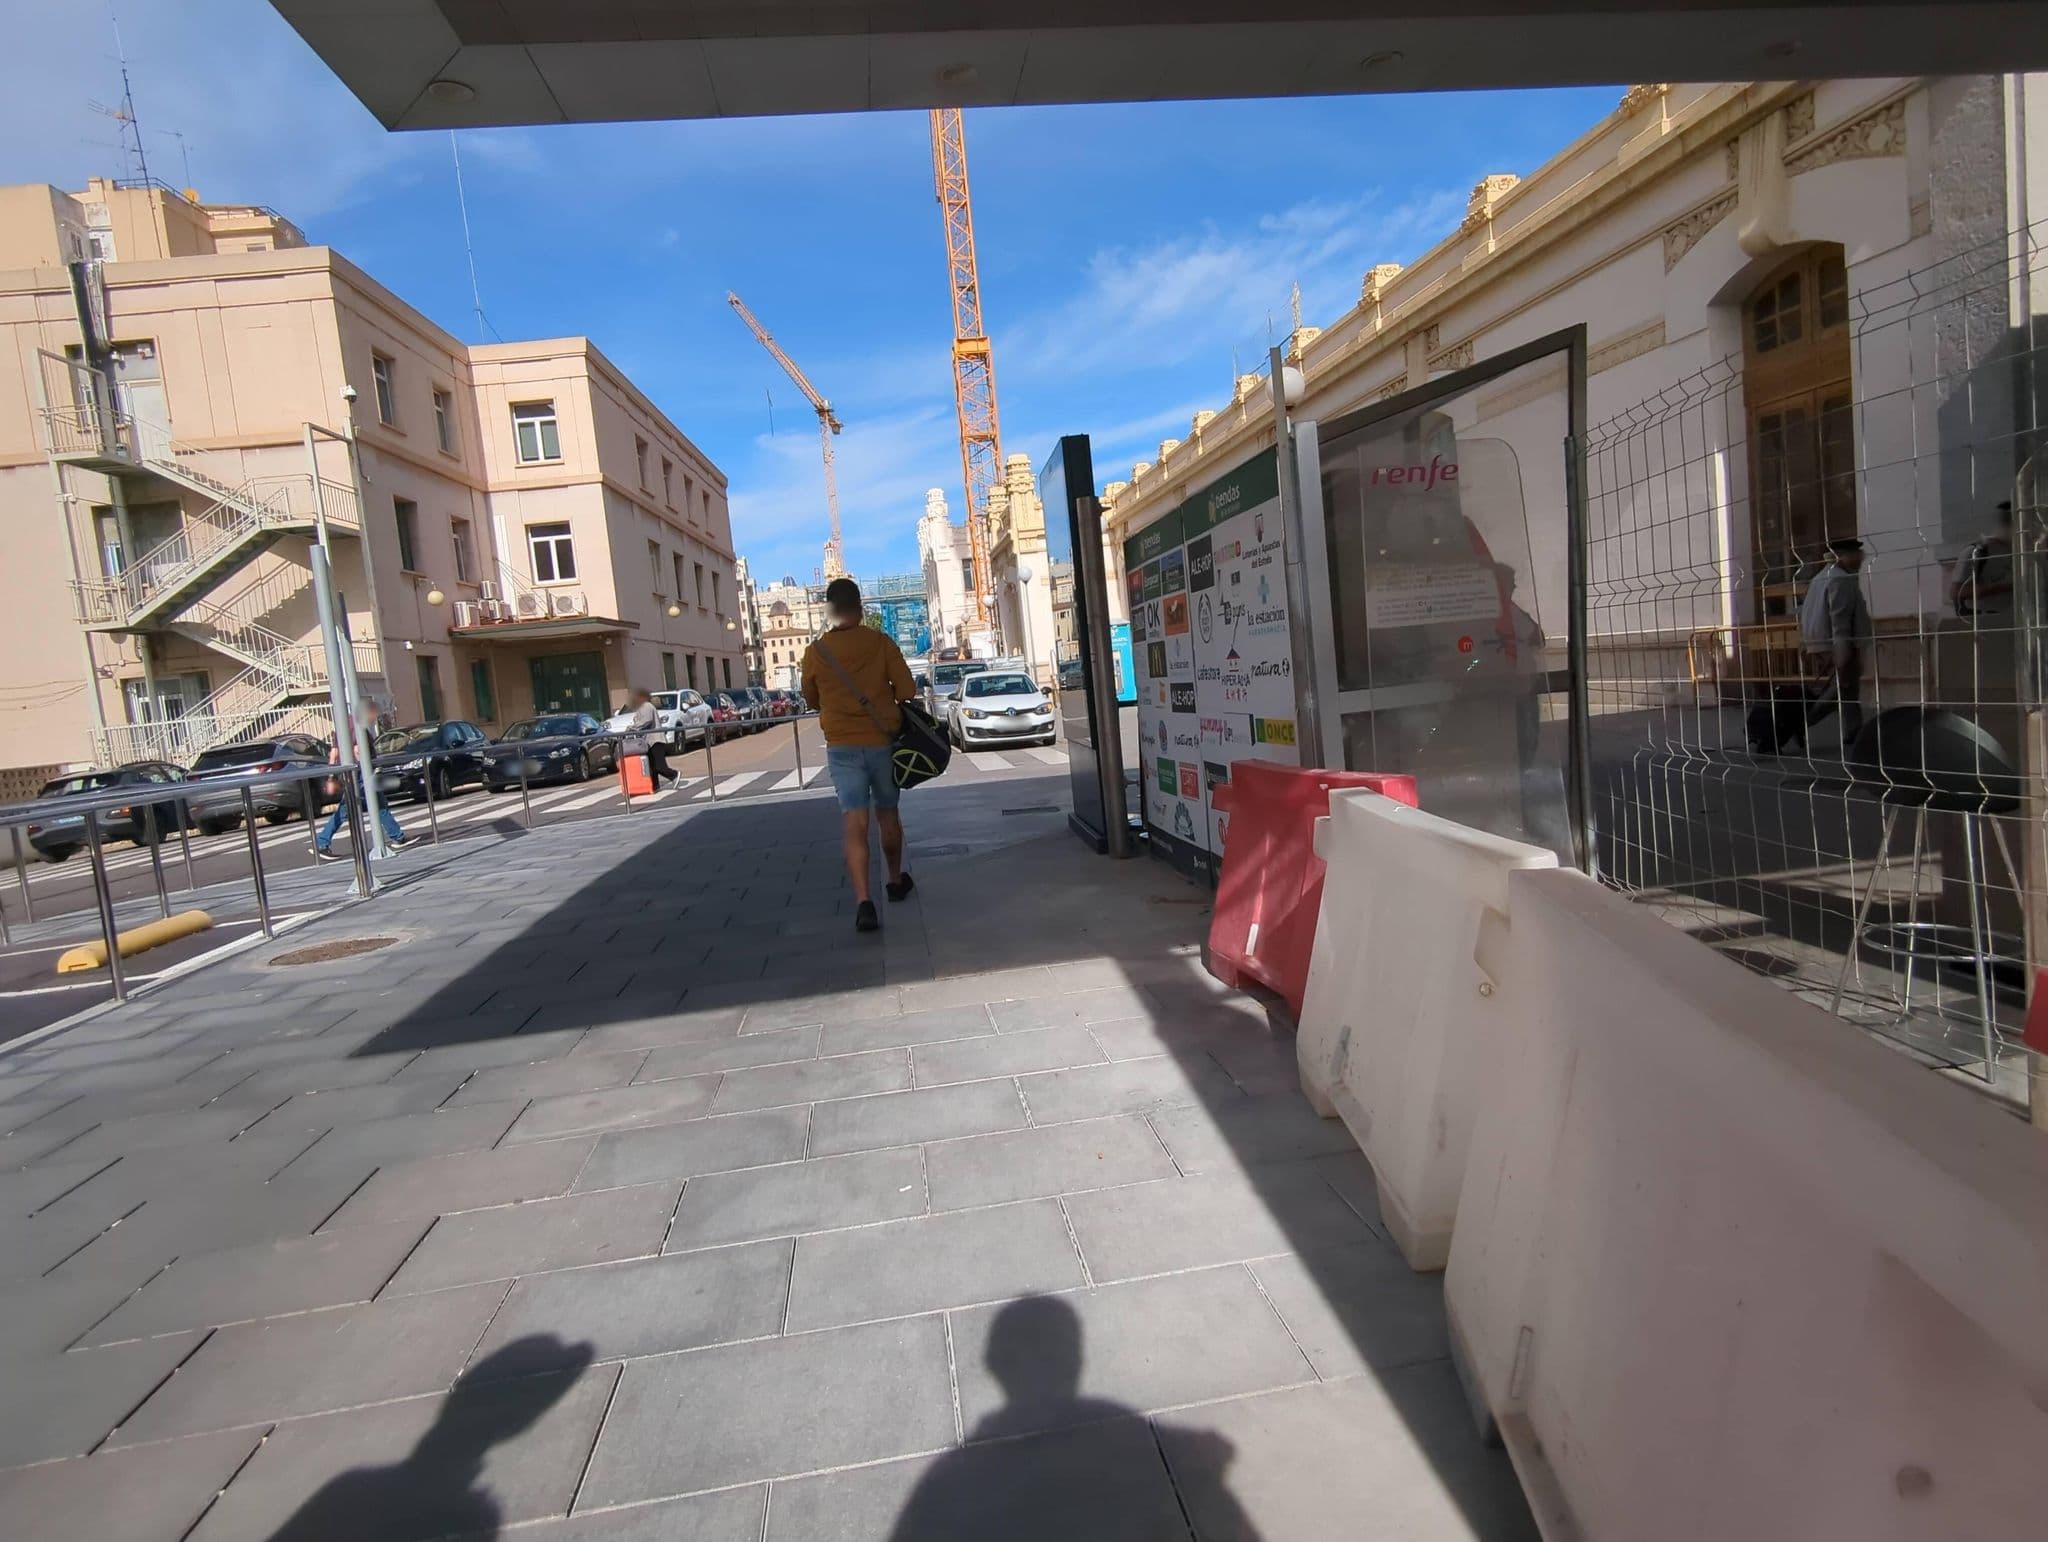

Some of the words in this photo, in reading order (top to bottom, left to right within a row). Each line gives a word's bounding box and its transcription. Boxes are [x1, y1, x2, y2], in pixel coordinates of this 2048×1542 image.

[1371, 454, 1459, 491] renfe
[1147, 603, 1161, 628] OK
[1248, 611, 1254, 626] la
[1255, 606, 1286, 624] estación
[1251, 660, 1282, 679] natura
[1266, 722, 1296, 743] ONCE
